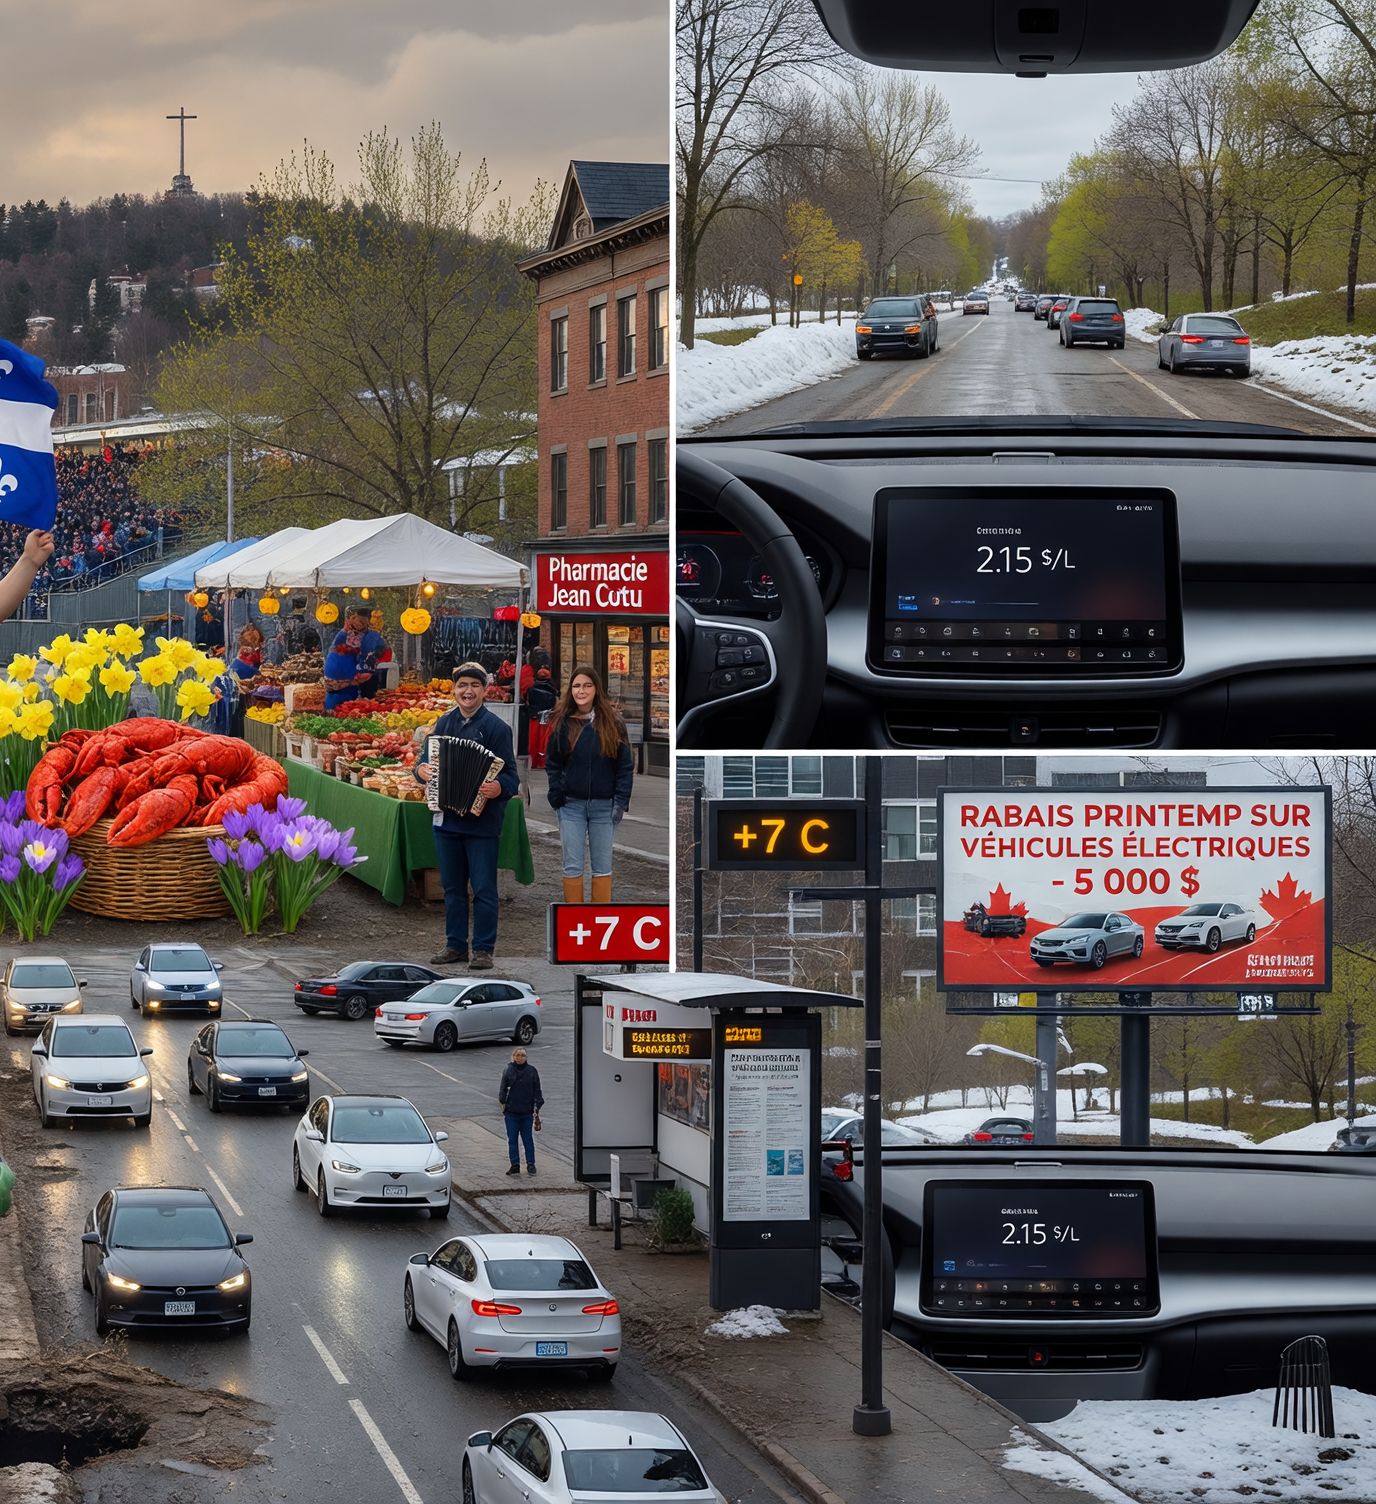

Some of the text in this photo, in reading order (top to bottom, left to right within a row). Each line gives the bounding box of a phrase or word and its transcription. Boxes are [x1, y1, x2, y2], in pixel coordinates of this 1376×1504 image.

[549, 555, 648, 582] Pharmacie
[976, 545, 1076, 574] 2.15 $/L
[547, 583, 591, 607] Jean
[960, 803, 1311, 828] RABAIS PRINTEMP SUR
[733, 817, 830, 855] +7 C
[961, 830, 1311, 861] VÉHICULES ÉLECTRIQUES
[1074, 867, 1094, 896] 5
[1103, 867, 1171, 896] 000
[1180, 865, 1201, 898] $
[568, 914, 663, 952] +7 C
[1001, 1222, 1047, 1245] 2.15
